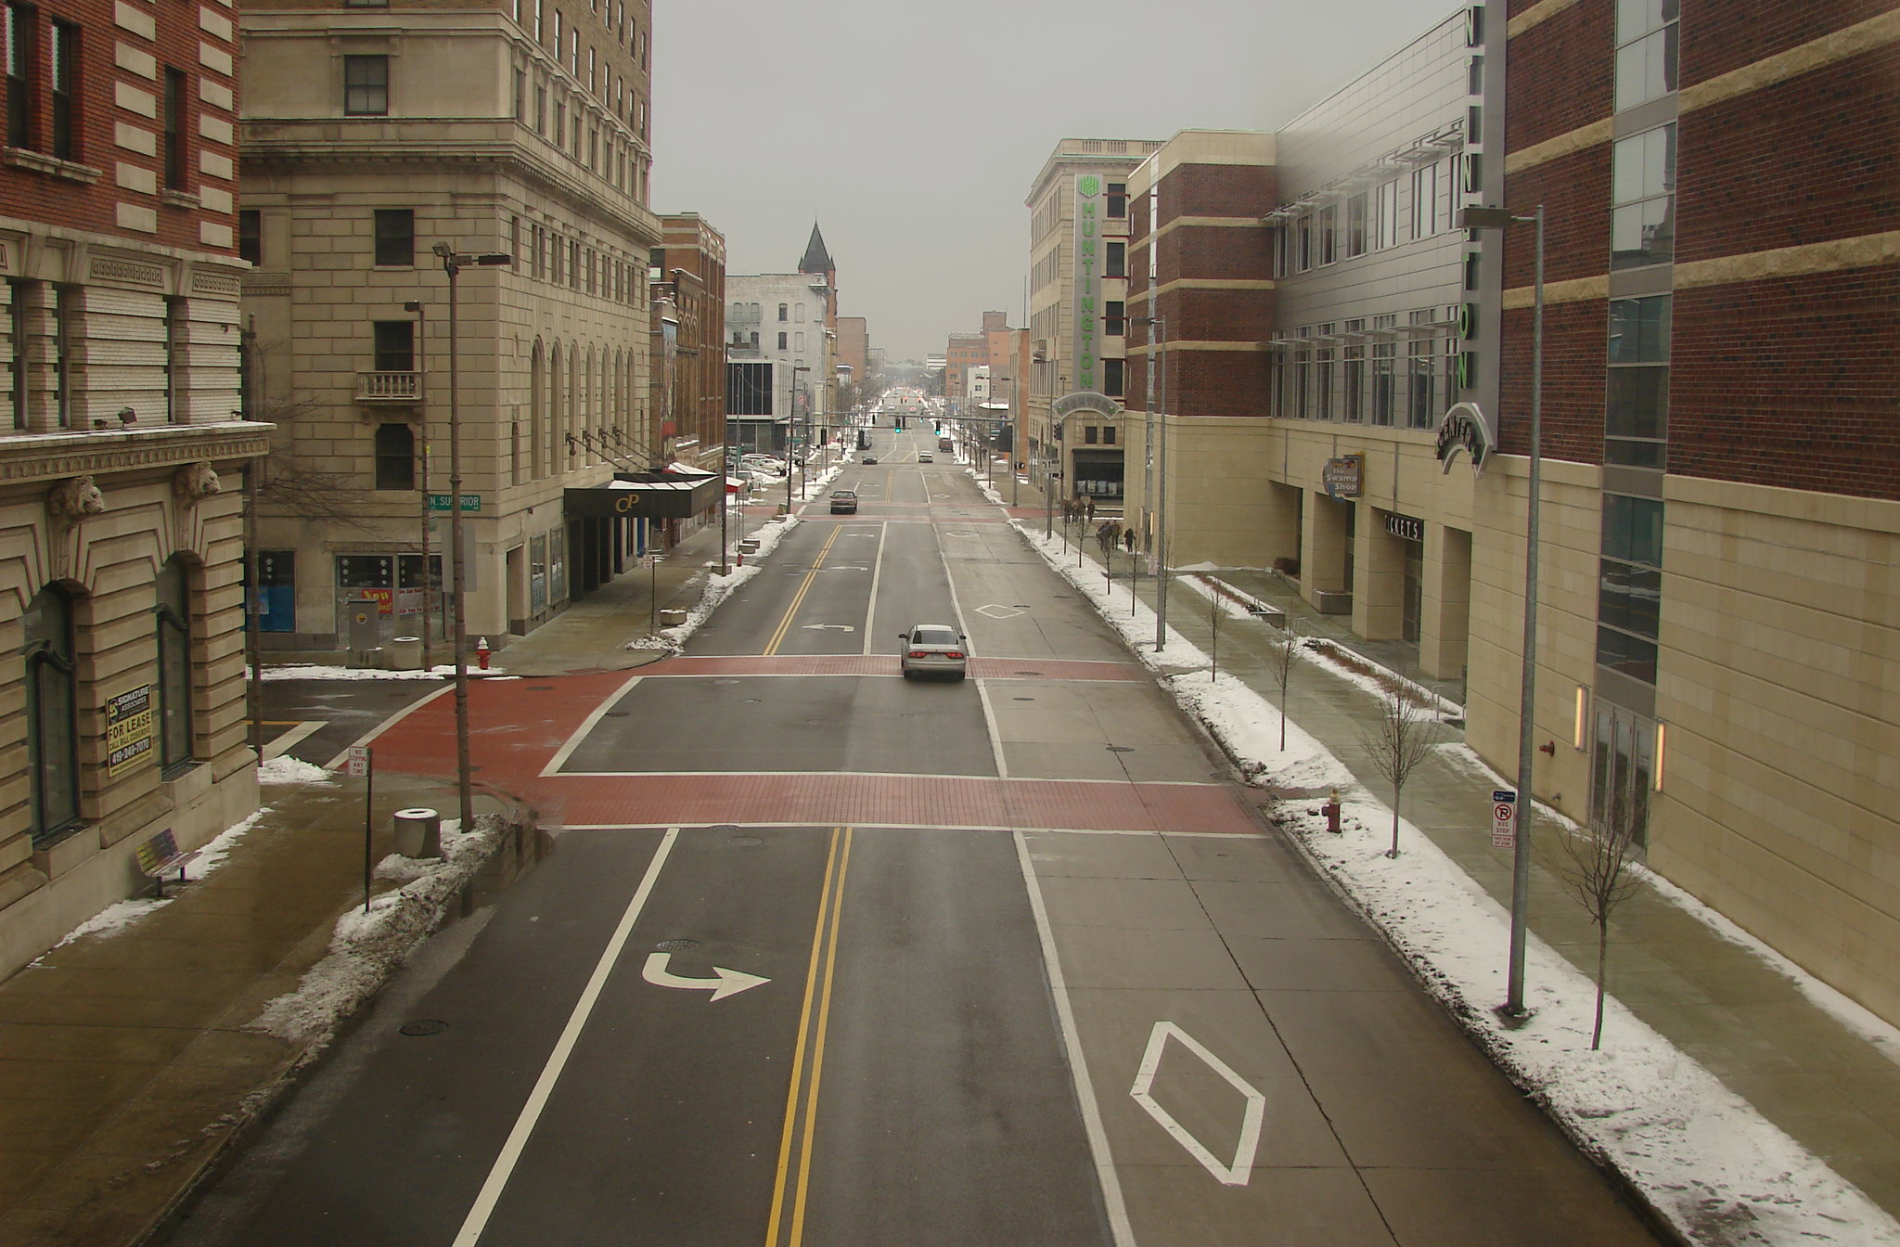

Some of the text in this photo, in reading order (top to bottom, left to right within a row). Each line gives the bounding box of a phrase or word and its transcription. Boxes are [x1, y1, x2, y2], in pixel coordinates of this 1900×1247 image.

[1080, 202, 1095, 388] HUNTINGTON
[1326, 474, 1358, 483] Swamp
[1334, 482, 1357, 491] Shop
[430, 496, 479, 506] N. SURIOR
[615, 493, 640, 513] CP
[1384, 514, 1418, 539] TICKETS
[363, 590, 389, 600] Now
[118, 686, 149, 705] SIGNATURE
[121, 696, 147, 712] ASSOCIATES
[109, 724, 124, 740] FOR
[127, 712, 150, 733] LEASE
